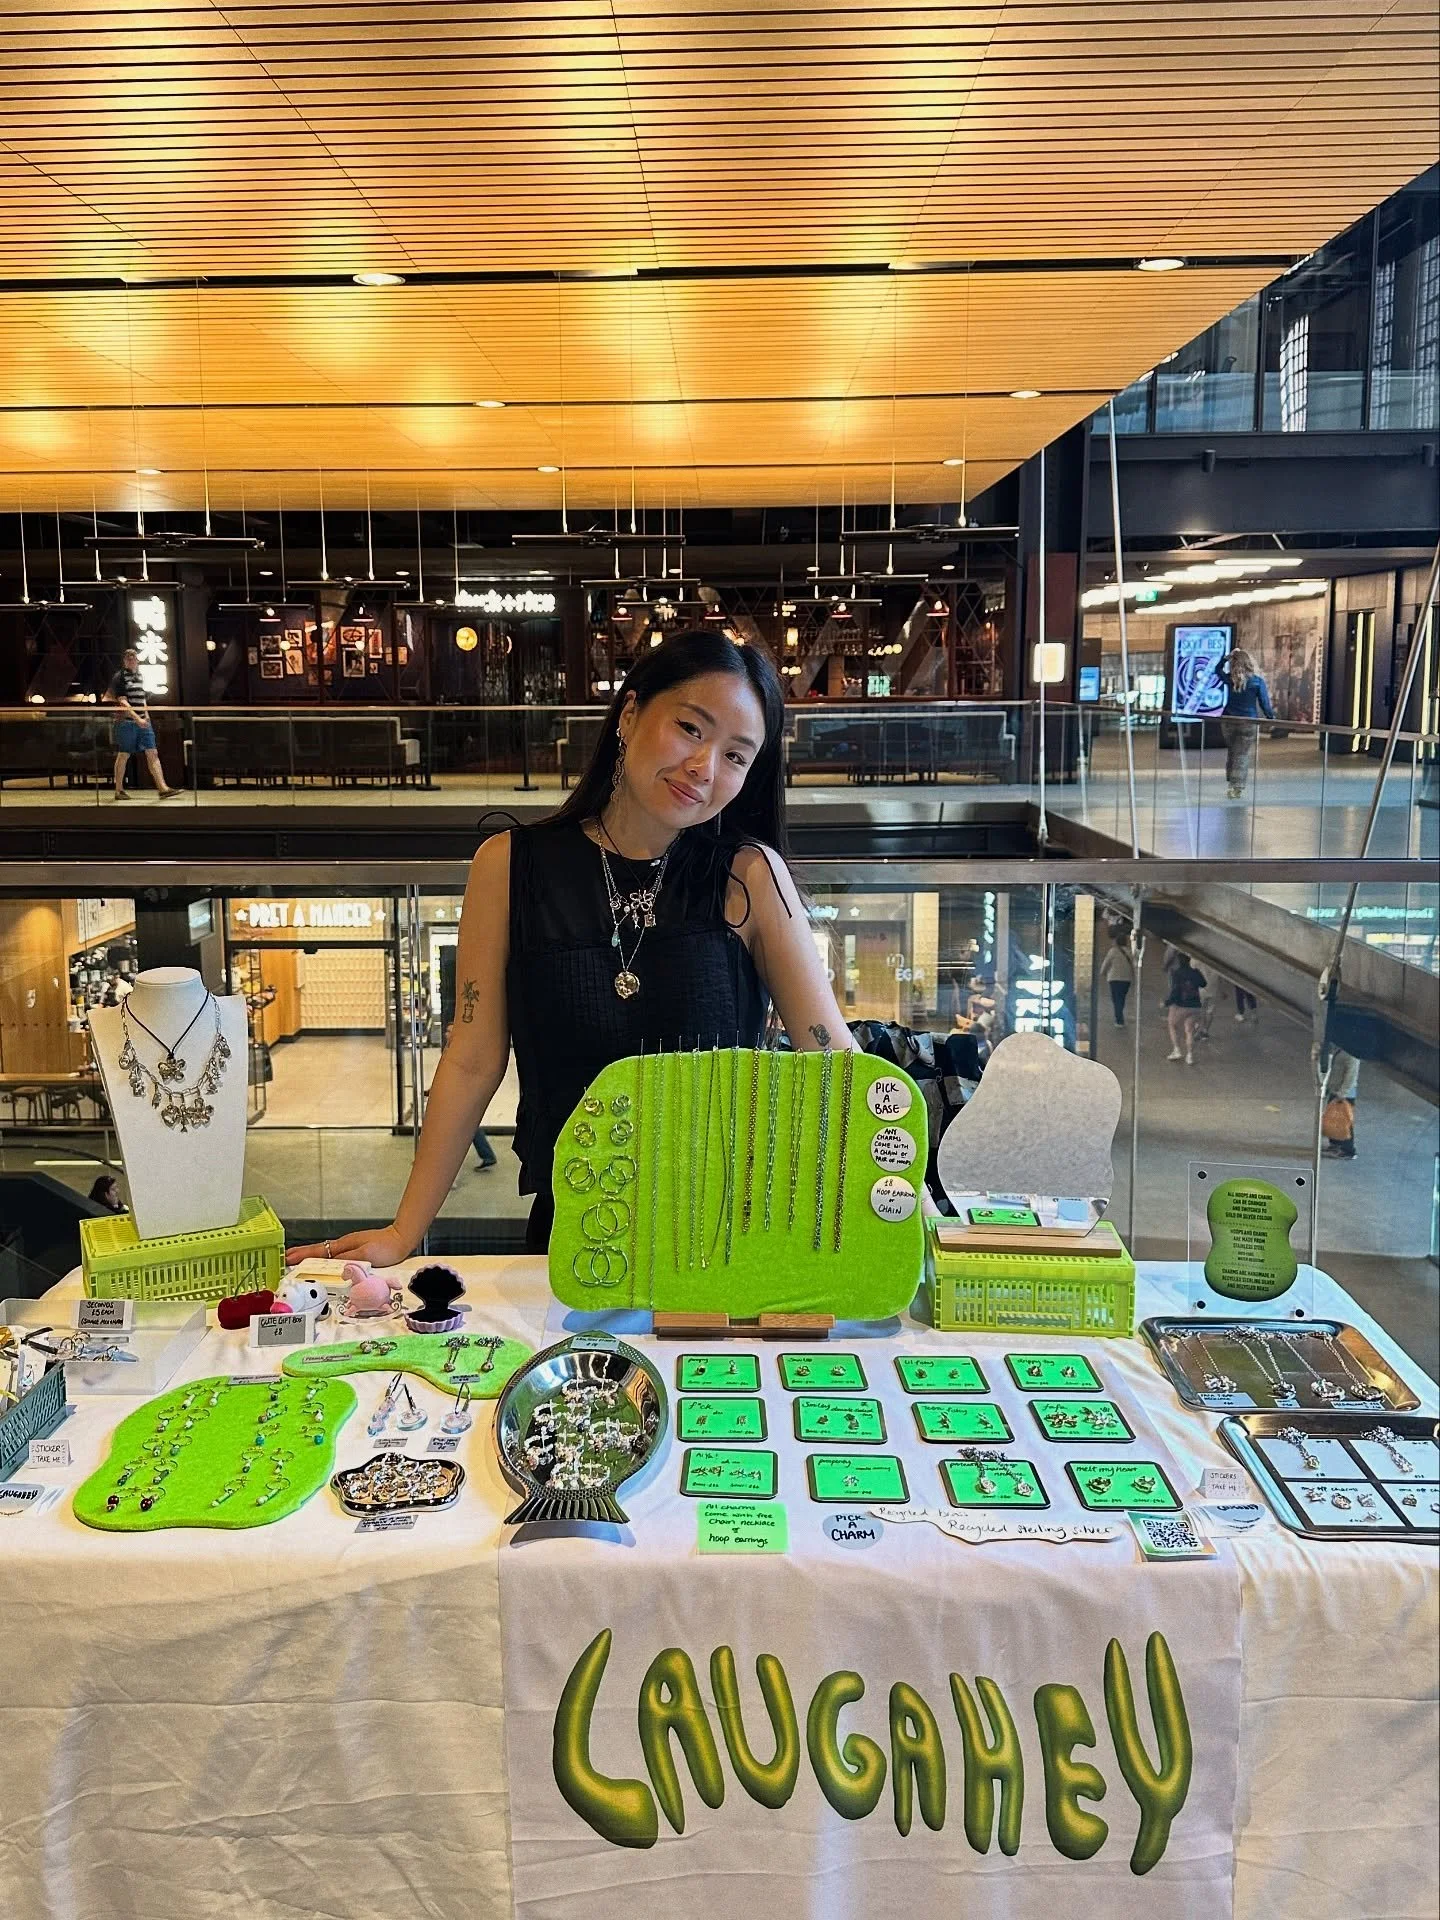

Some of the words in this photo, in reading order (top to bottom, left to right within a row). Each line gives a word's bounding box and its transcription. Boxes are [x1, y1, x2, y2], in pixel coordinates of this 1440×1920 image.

[249, 903, 289, 927] PRET
[875, 1082, 899, 1094] PICK
[883, 1094, 890, 1103] A
[875, 1104, 900, 1114] BASE
[878, 1204, 902, 1214] CHAIN
[260, 1317, 276, 1326] CUTE
[1099, 1467, 1114, 1477] my
[831, 1528, 875, 1541] CHARM
[949, 1520, 1006, 1540] Recycled
[709, 1533, 730, 1544] hoop
[734, 1537, 768, 1548] earrings
[553, 1628, 1192, 1876] LAUGAHEY
